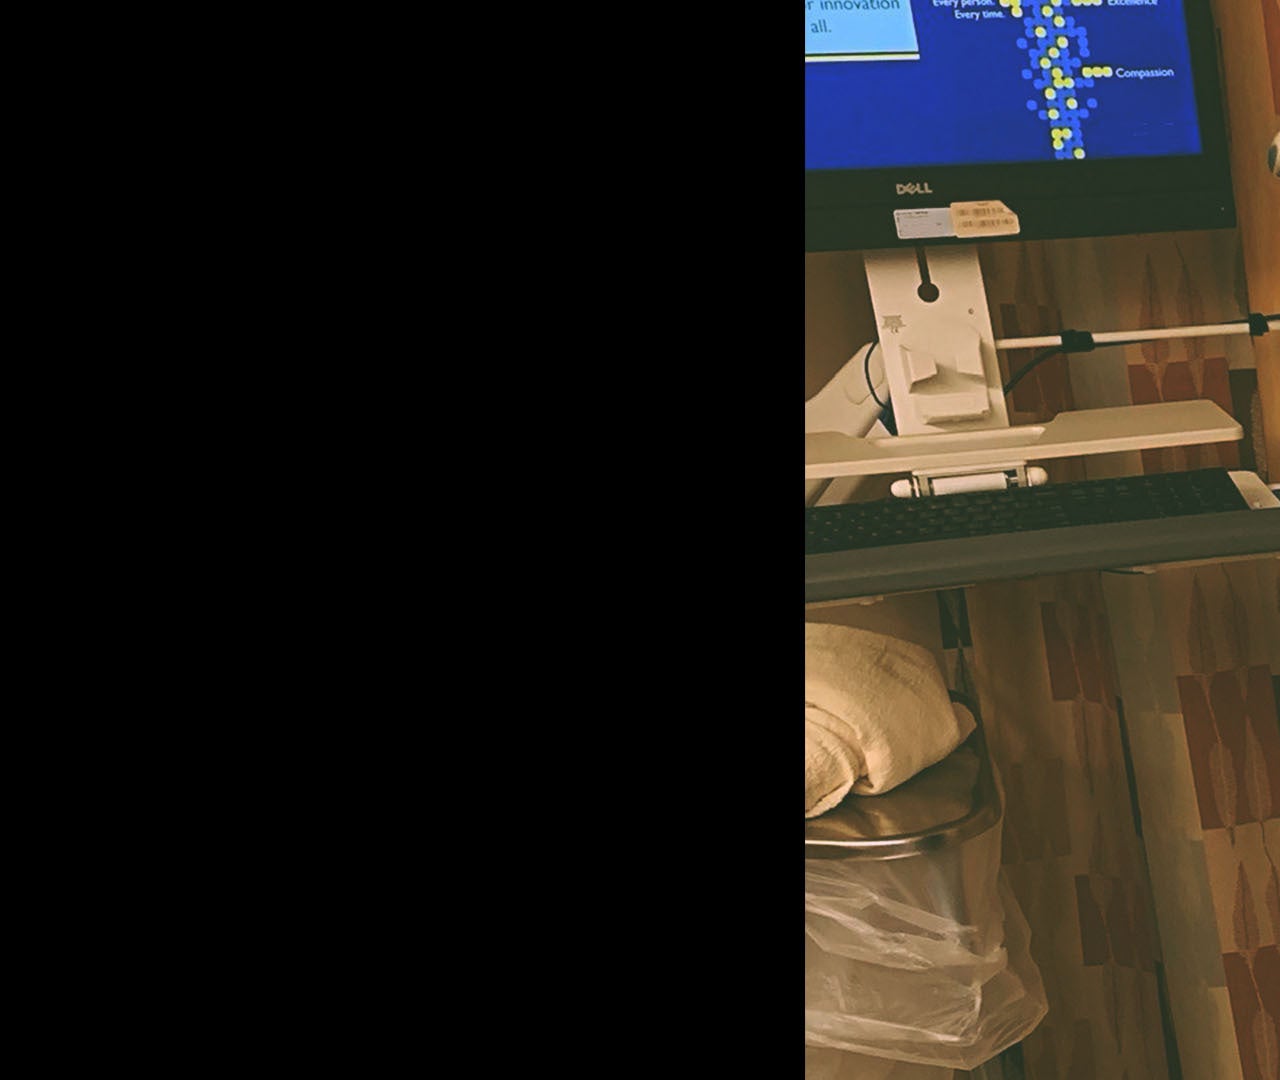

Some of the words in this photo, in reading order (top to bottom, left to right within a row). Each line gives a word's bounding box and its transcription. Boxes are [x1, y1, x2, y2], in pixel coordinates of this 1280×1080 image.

[954, 9, 980, 21] Every
[811, 19, 832, 33] all.
[1115, 67, 1175, 79] Compassion
[896, 182, 932, 194] DELL
